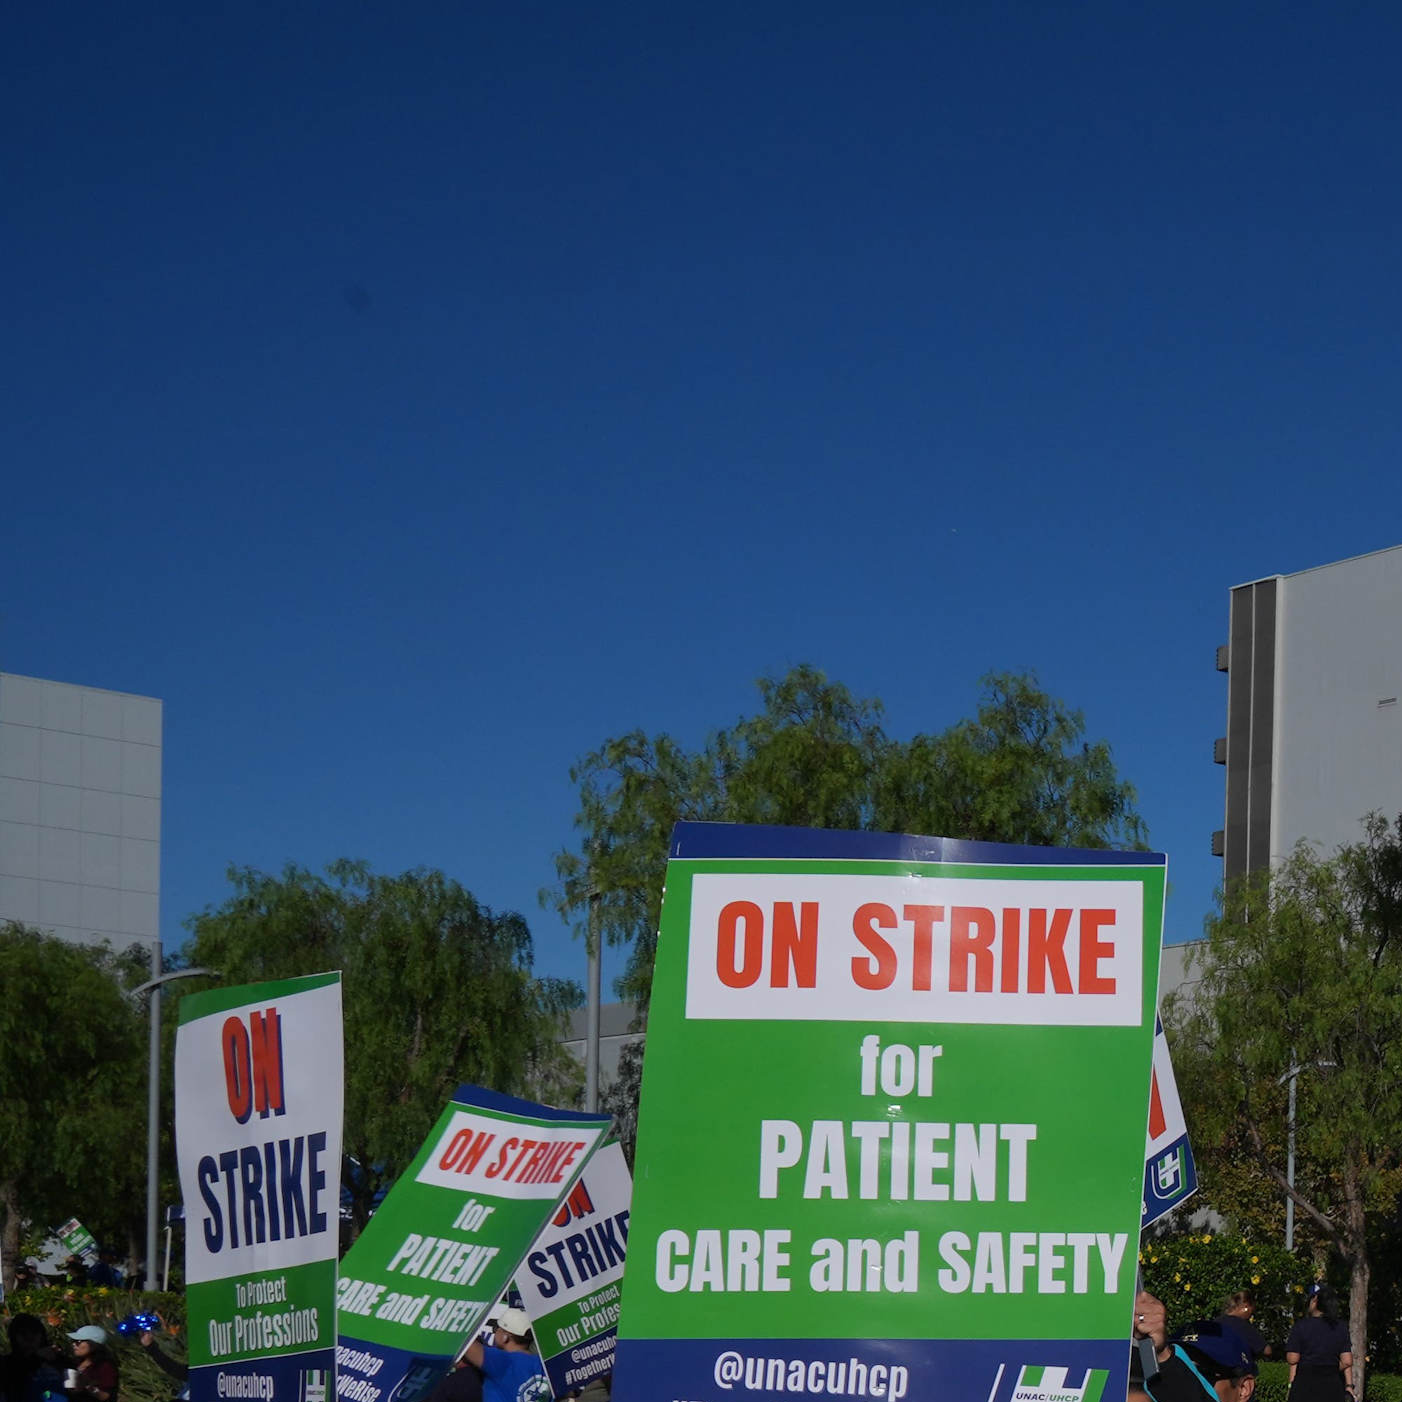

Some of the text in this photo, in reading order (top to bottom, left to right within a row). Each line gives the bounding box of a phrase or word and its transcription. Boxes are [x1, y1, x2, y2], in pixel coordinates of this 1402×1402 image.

[715, 900, 1117, 995] ON STRIKE
[222, 1007, 286, 1125] ON
[860, 1035, 943, 1097] for
[439, 1128, 586, 1184] ON STRIKE
[759, 1119, 1037, 1202] PATIENT
[198, 1131, 327, 1254] STRIKE
[452, 1199, 496, 1233] for
[386, 1233, 500, 1287] PATIENT
[655, 1228, 1129, 1294] CARE and SAFETY
[235, 1276, 287, 1308] To Protect
[376, 1292, 431, 1326] and
[577, 1285, 621, 1315] To Protect
[209, 1304, 319, 1356] Our Professions
[556, 1322, 581, 1347] Our
[217, 1371, 274, 1402] @unacuhcp
[713, 1351, 909, 1401] @unacuhcp
[1015, 1392, 1080, 1402] UNAC/UHCP
